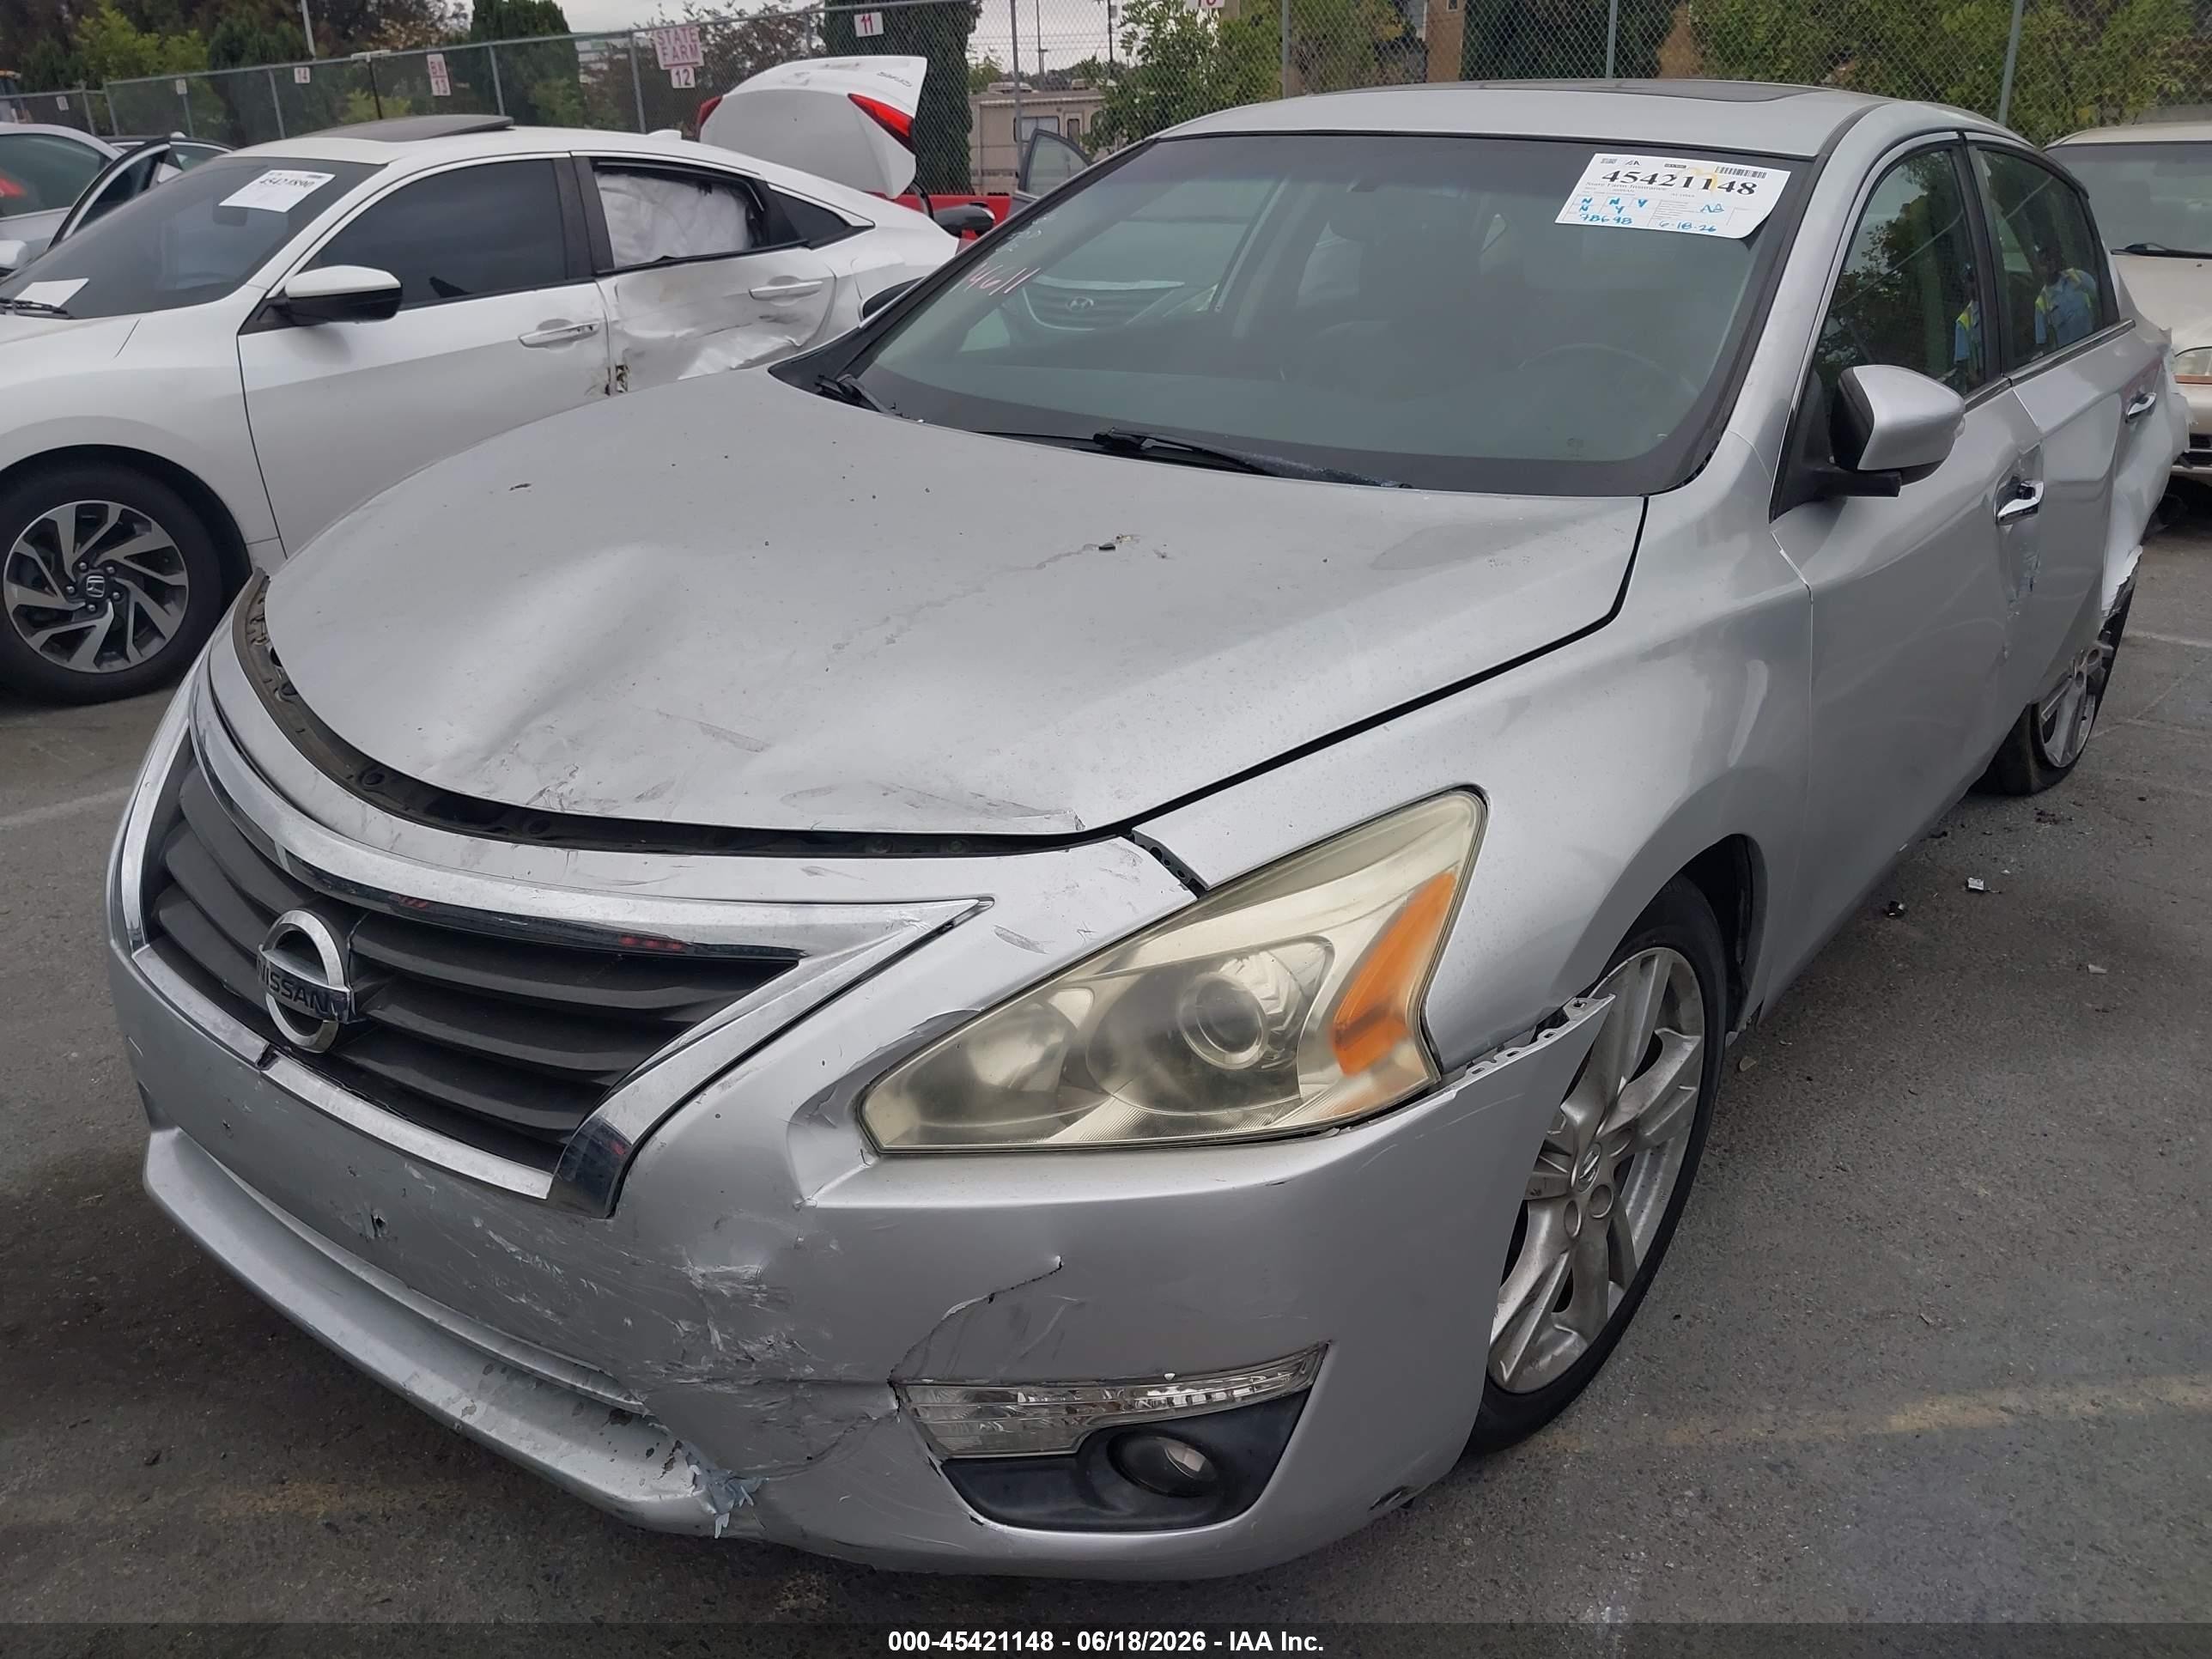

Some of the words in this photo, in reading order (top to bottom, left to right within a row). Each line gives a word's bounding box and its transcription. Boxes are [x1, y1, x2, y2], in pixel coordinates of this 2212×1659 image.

[860, 13, 874, 34] 11
[656, 27, 699, 46] STATE
[661, 44, 698, 62] FARM
[674, 68, 692, 87] 12
[1601, 170, 1758, 196] 45421148
[258, 955, 331, 1015] NISSAN
